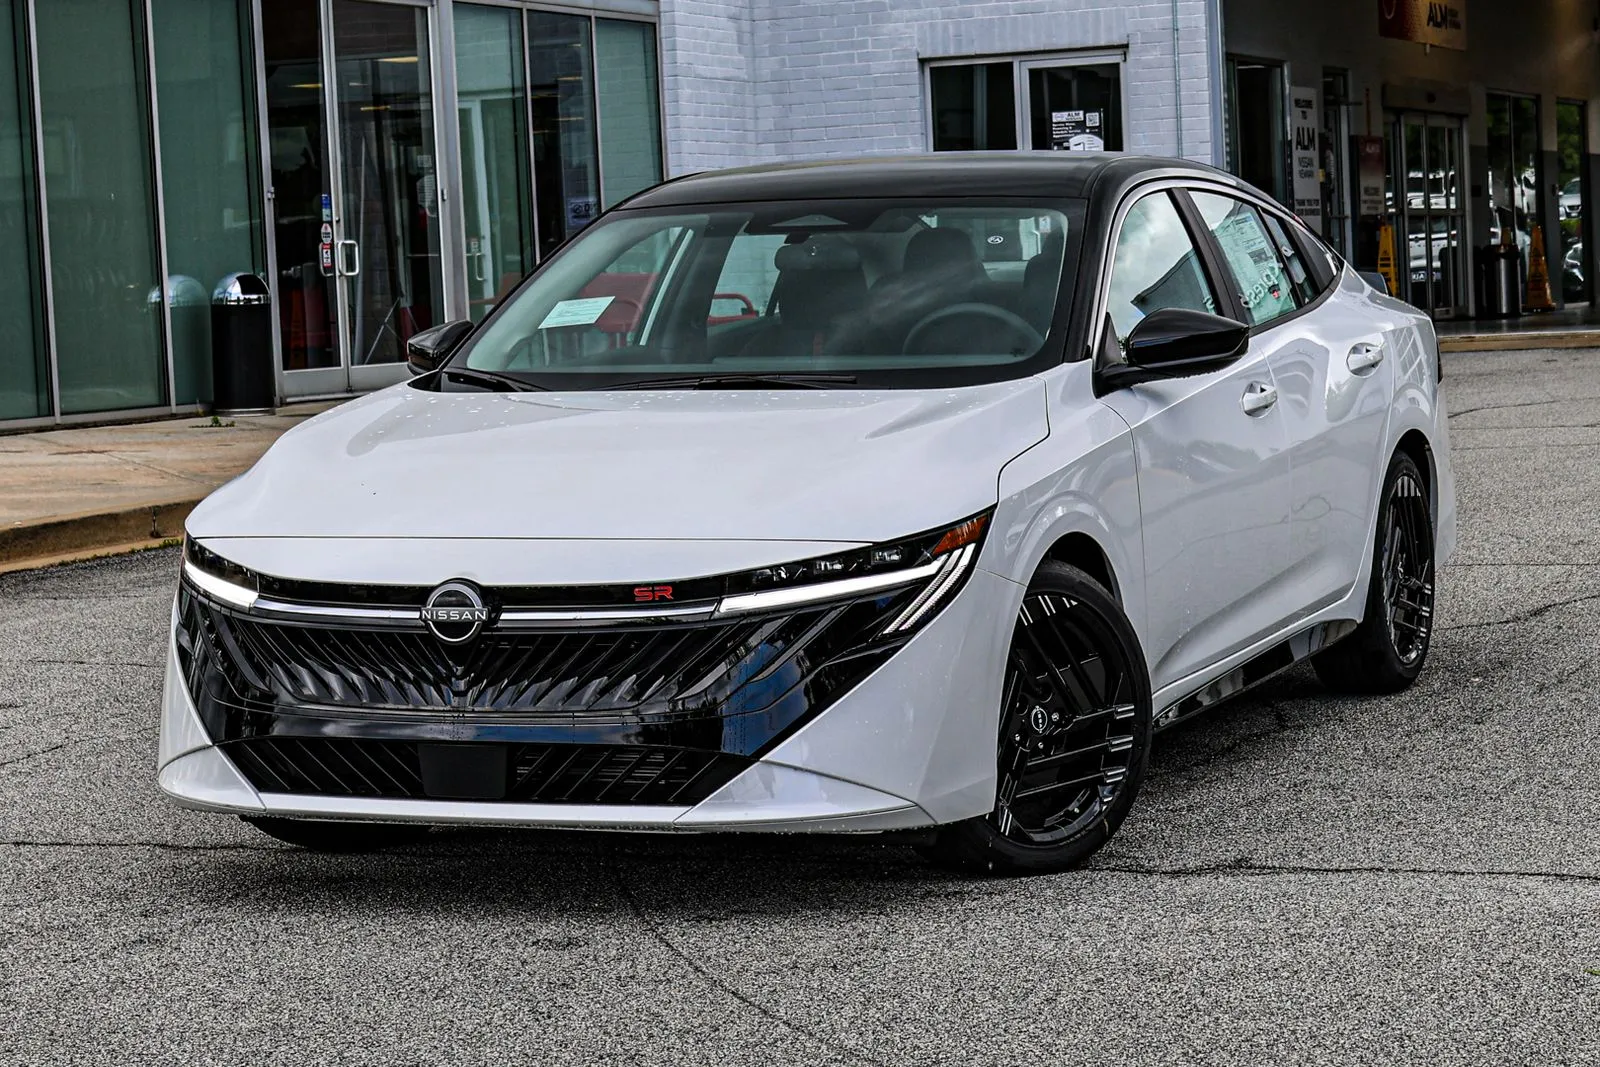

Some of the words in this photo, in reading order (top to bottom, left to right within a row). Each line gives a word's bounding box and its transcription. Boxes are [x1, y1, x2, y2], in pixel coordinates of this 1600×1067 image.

[1427, 2, 1447, 29] ALM
[1296, 126, 1316, 151] ALM
[633, 585, 673, 602] SR
[422, 609, 487, 621] NISSAN
